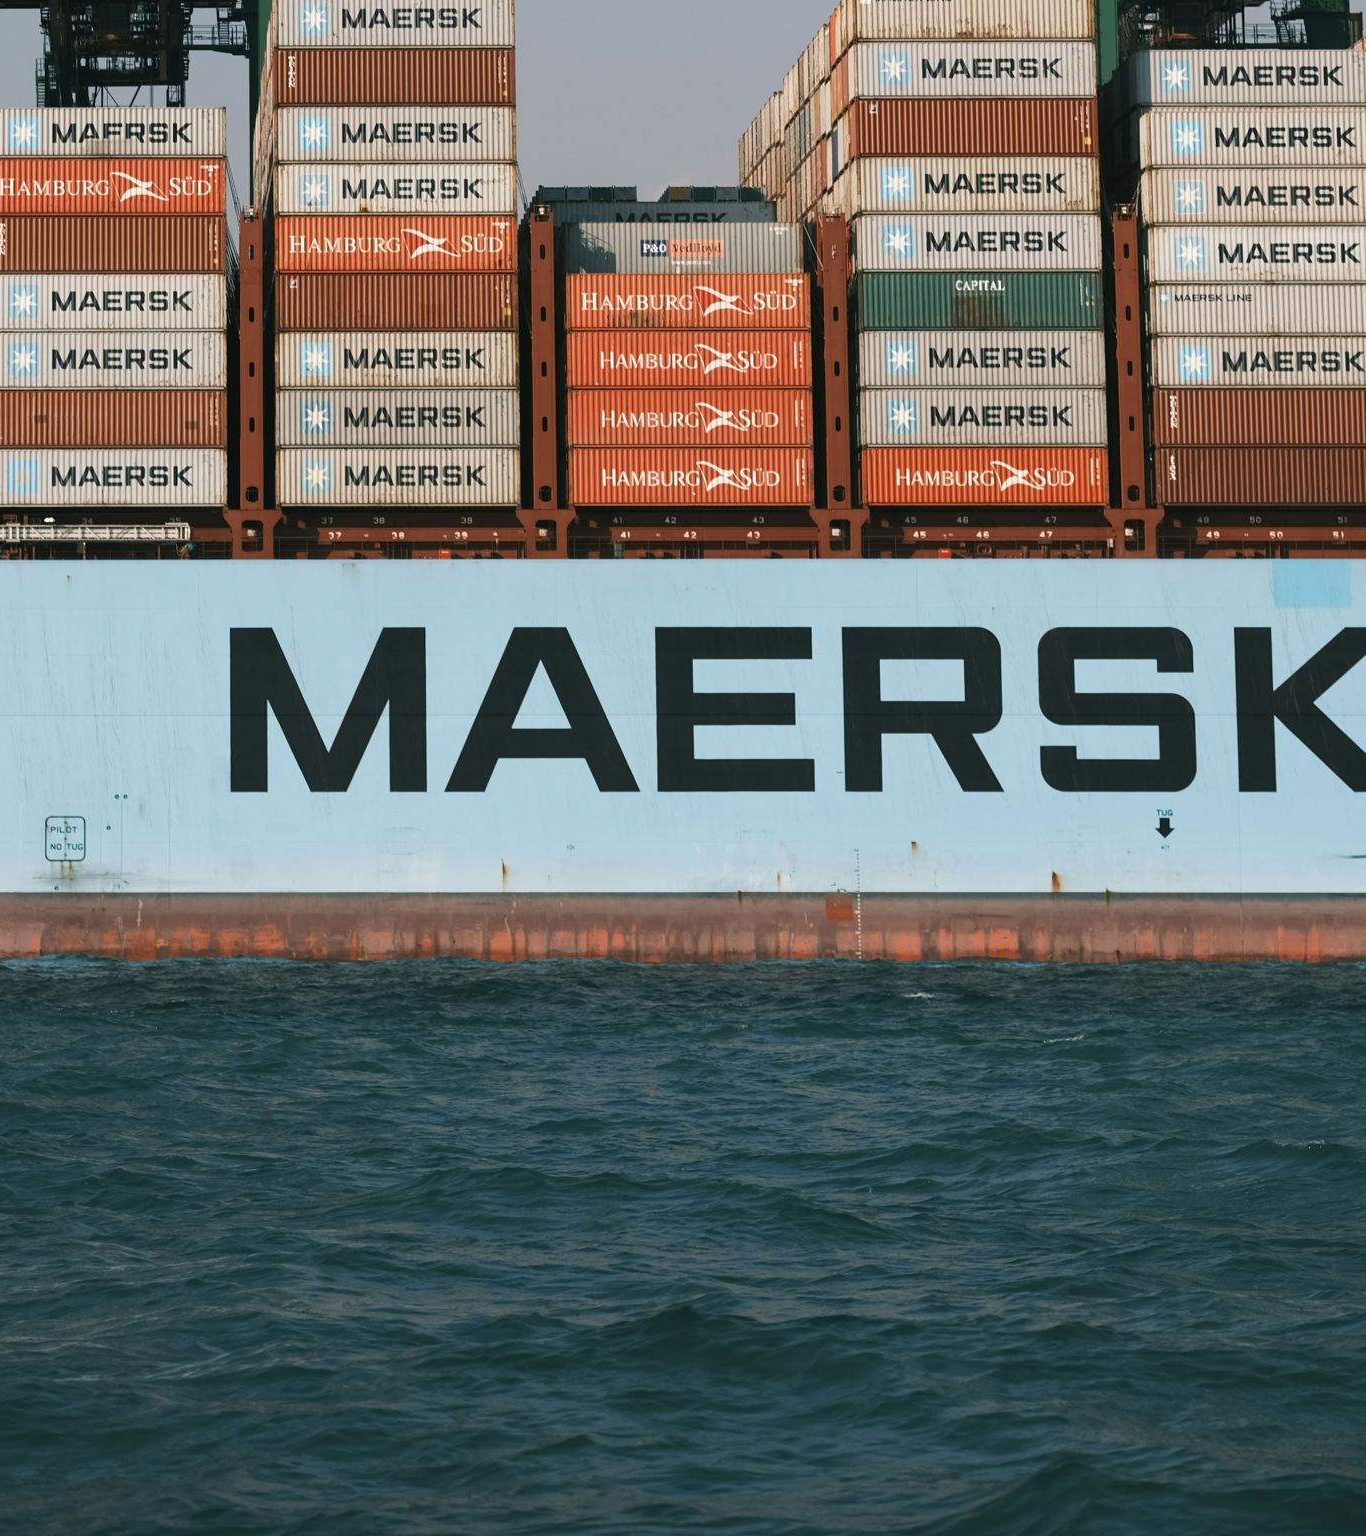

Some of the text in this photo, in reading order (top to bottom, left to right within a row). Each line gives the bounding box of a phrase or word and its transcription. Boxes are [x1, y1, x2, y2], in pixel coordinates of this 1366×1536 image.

[342, 8, 482, 29] MAERSK
[922, 58, 1062, 79] MAERSK
[1203, 66, 1343, 86] MAERSK
[342, 123, 482, 143] MAERSK
[1215, 127, 1356, 148] MAERSK
[167, 176, 212, 196] SÜD
[342, 179, 482, 199] MAERSK
[925, 173, 1066, 194] MAERSK
[1217, 186, 1358, 206] MAERSK
[289, 233, 503, 253] HAMBURG SÜD
[643, 243, 666, 253] P&O
[926, 231, 1067, 252] MAERSK
[1219, 243, 1360, 264] MAERSK
[956, 280, 1005, 291] CAPITAL
[51, 291, 193, 312] MAERSK
[581, 291, 796, 312] HAMBURG SÜD
[1174, 294, 1253, 302] MAERSK LINE
[51, 349, 193, 370] MAERSK
[343, 349, 485, 369] MAERSK
[600, 350, 777, 369] HAMBURG SÜD
[929, 347, 1071, 369] MAERSK
[1223, 351, 1365, 372] MAERSK
[344, 407, 486, 428] MAERSK
[601, 409, 778, 428] HAMBURG SÜD
[931, 406, 1073, 427] MAERSK
[51, 466, 193, 487] MAERSK
[345, 466, 487, 486] MAERSK
[603, 467, 780, 487] HAMBURG SÜD
[897, 467, 1075, 486] HAMBURG SÜD
[51, 826, 77, 834] PILOT
